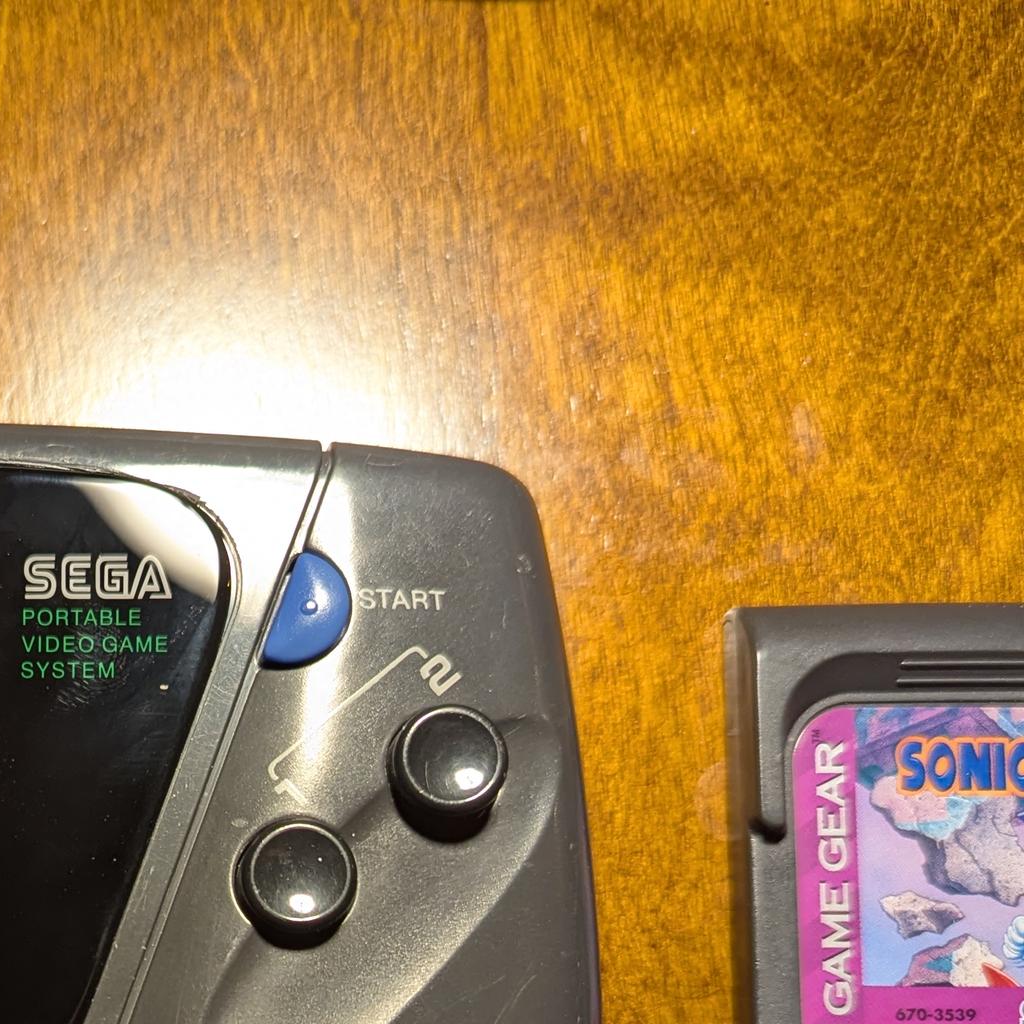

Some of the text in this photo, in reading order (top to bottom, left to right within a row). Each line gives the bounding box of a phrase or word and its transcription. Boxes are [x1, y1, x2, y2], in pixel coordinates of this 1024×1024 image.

[23, 553, 173, 600] SEGA
[358, 588, 446, 611] START
[22, 608, 142, 626] PORTABLE
[21, 635, 168, 653] VIDEO GAME
[21, 661, 115, 679] SYSTEM
[420, 653, 462, 697] 2
[815, 741, 848, 873] GEAR
[820, 880, 853, 1016] GAME
[895, 1008, 977, 1022] 670-3539
